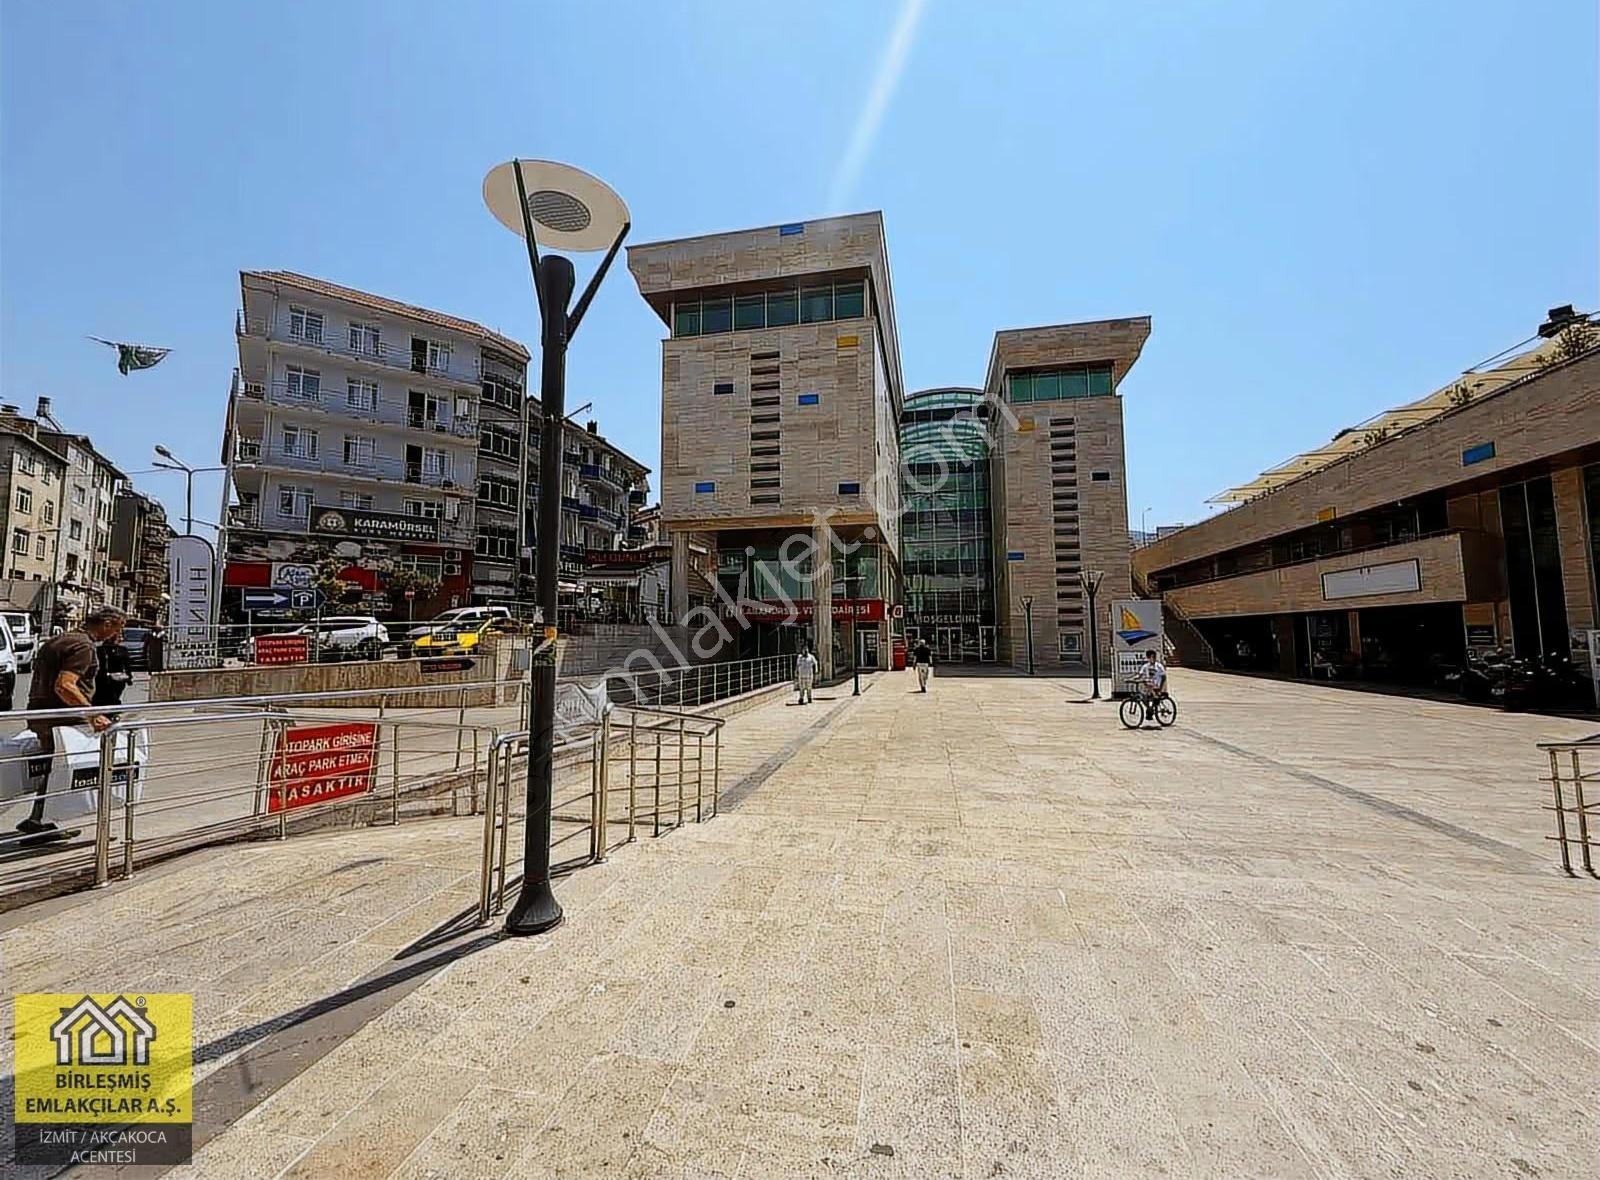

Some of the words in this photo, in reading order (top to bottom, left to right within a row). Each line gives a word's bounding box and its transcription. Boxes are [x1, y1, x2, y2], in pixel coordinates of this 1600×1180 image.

[354, 517, 437, 533] KARAMÜRSEL
[300, 595, 309, 606] P
[284, 737, 331, 753] TOPARK
[333, 730, 372, 747] GİRİŞİNE
[274, 761, 306, 777] ARAÇ
[308, 757, 337, 772] PARK
[338, 750, 370, 767] ETMEK
